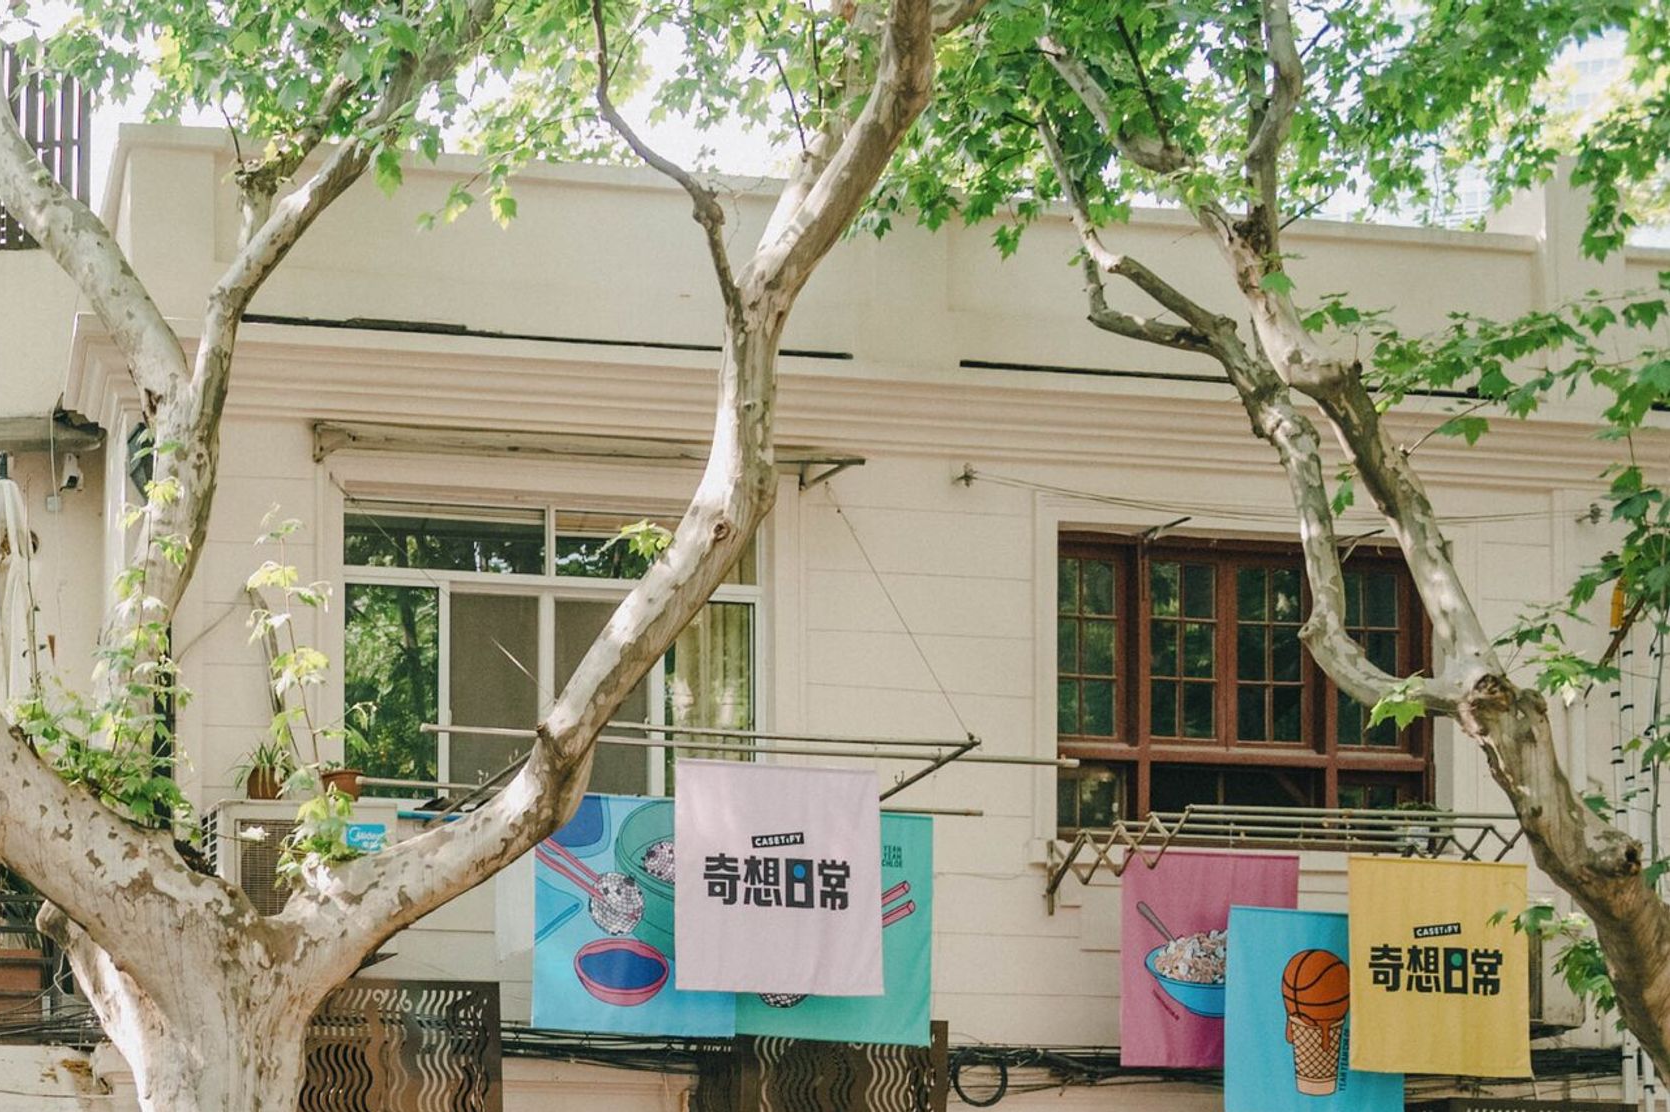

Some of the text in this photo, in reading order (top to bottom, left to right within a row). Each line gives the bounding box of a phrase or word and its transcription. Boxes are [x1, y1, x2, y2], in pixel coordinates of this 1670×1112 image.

[703, 853, 850, 910] 奇想日常
[1369, 944, 1503, 996] 奇想日常
